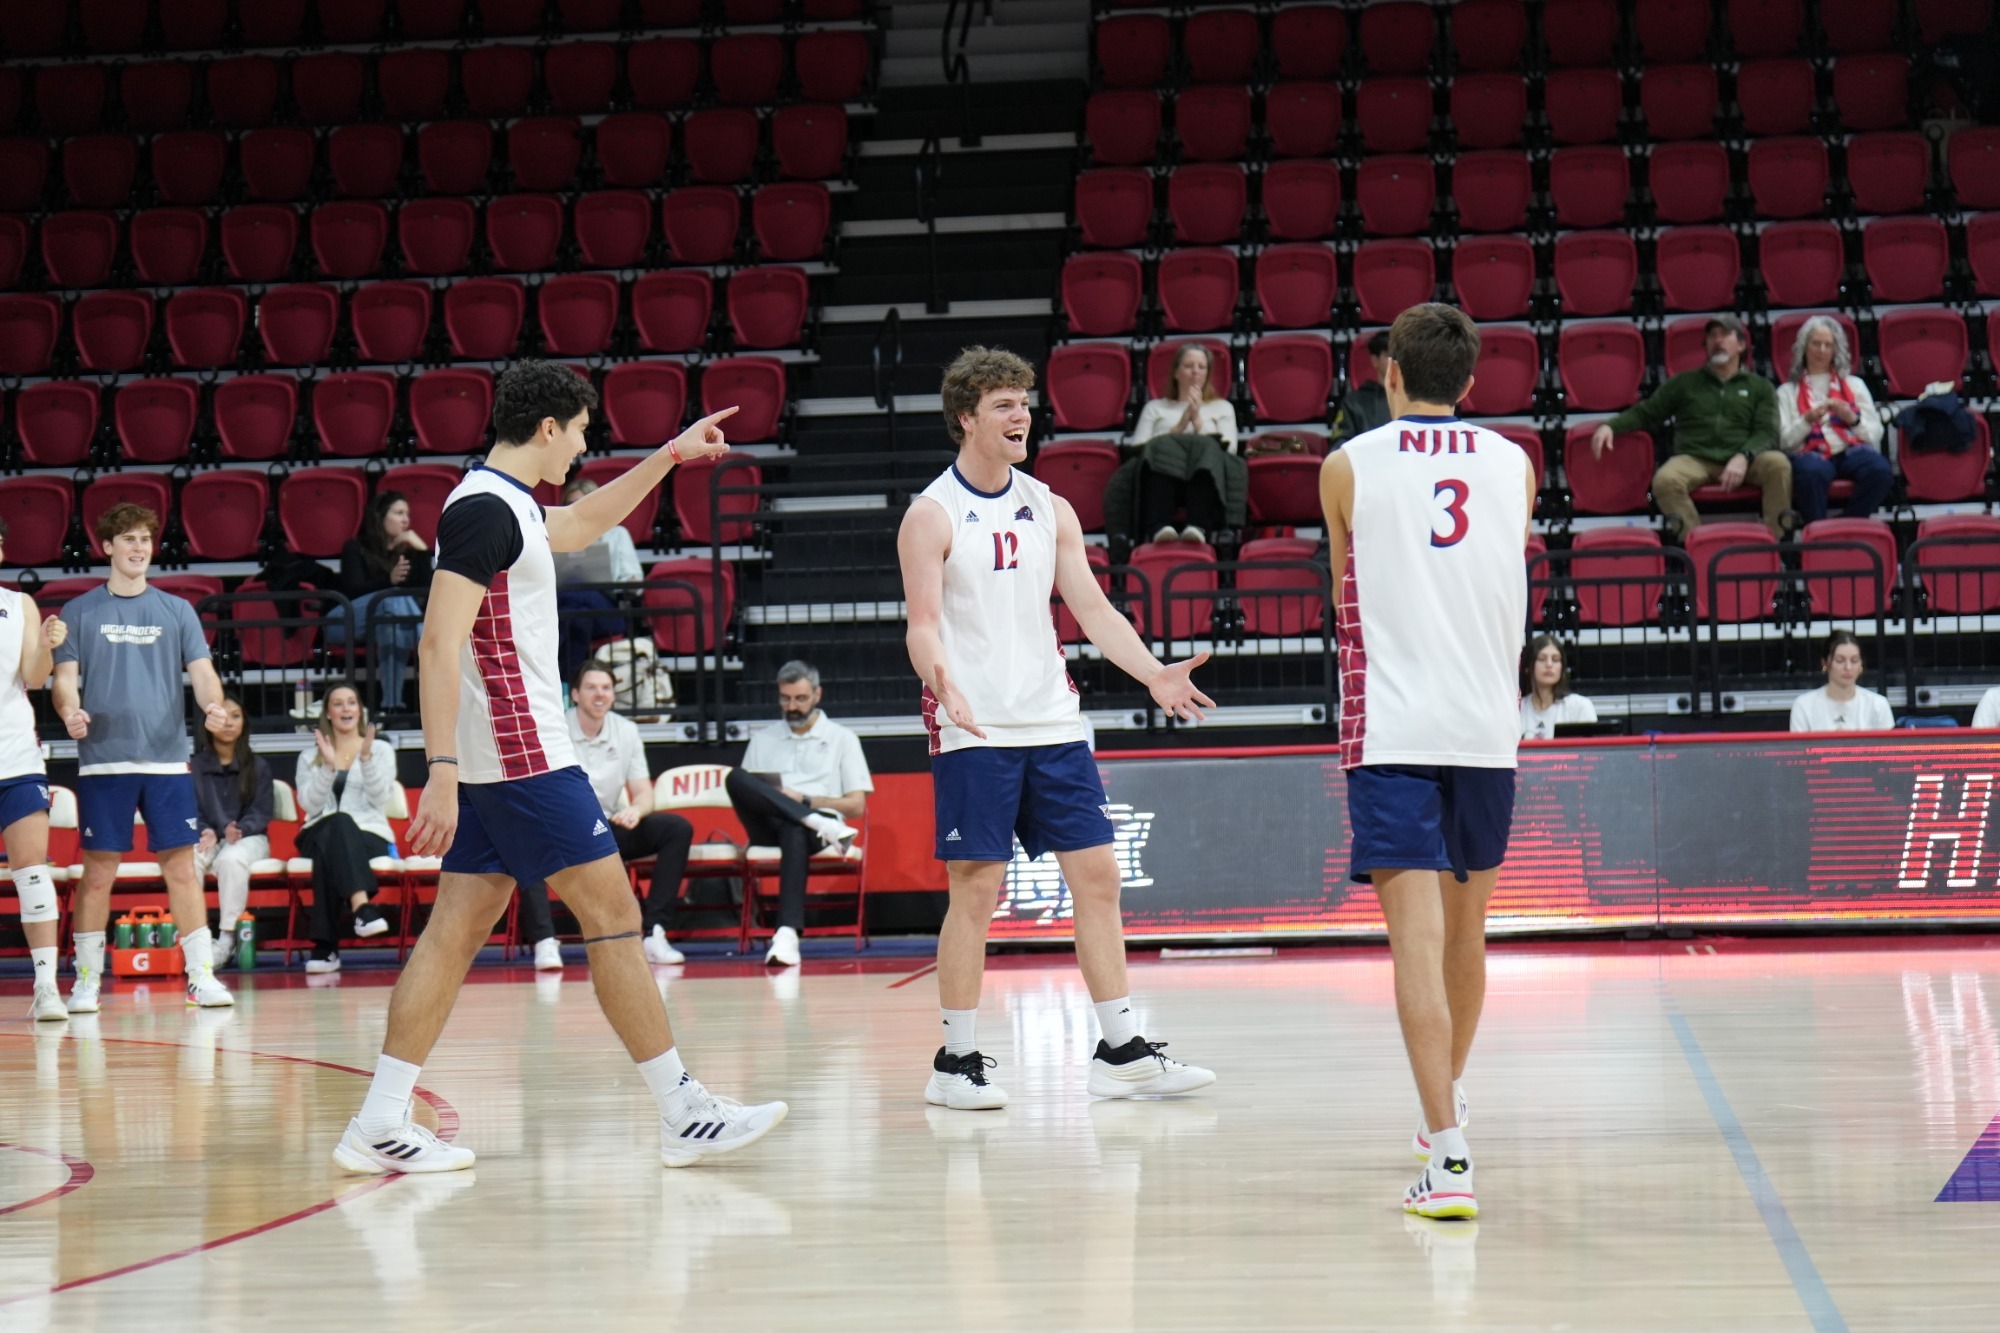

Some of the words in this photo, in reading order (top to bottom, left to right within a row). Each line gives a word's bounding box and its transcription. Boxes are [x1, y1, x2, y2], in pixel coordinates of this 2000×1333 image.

[1399, 429, 1478, 456] NJIT
[1430, 478, 1469, 548] 3
[992, 531, 1018, 571] 12
[100, 624, 163, 636] HIGHLANDERS
[672, 767, 726, 799] NJIT
[132, 952, 150, 972] G
